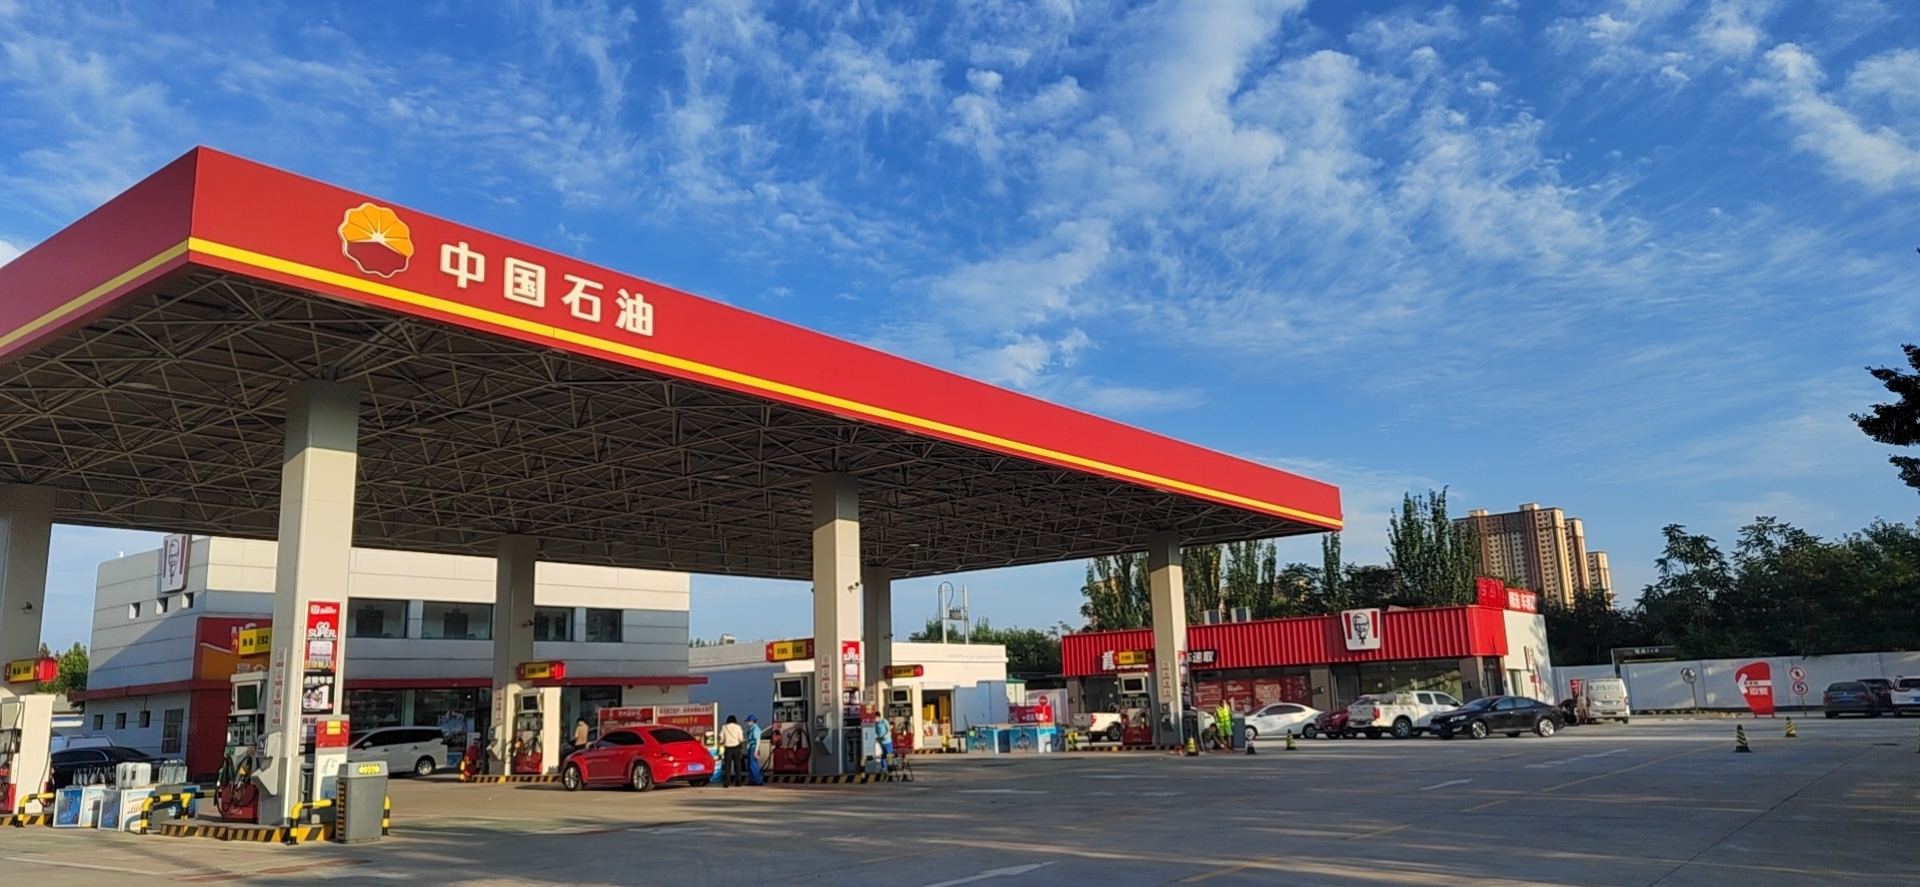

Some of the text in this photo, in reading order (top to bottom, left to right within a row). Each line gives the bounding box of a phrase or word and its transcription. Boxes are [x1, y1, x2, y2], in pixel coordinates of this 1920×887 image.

[440, 241, 654, 337] 中国石油
[316, 621, 330, 630] GO
[257, 635, 269, 645] E92
[777, 647, 788, 655] E95
[1796, 683, 1804, 692] 5
